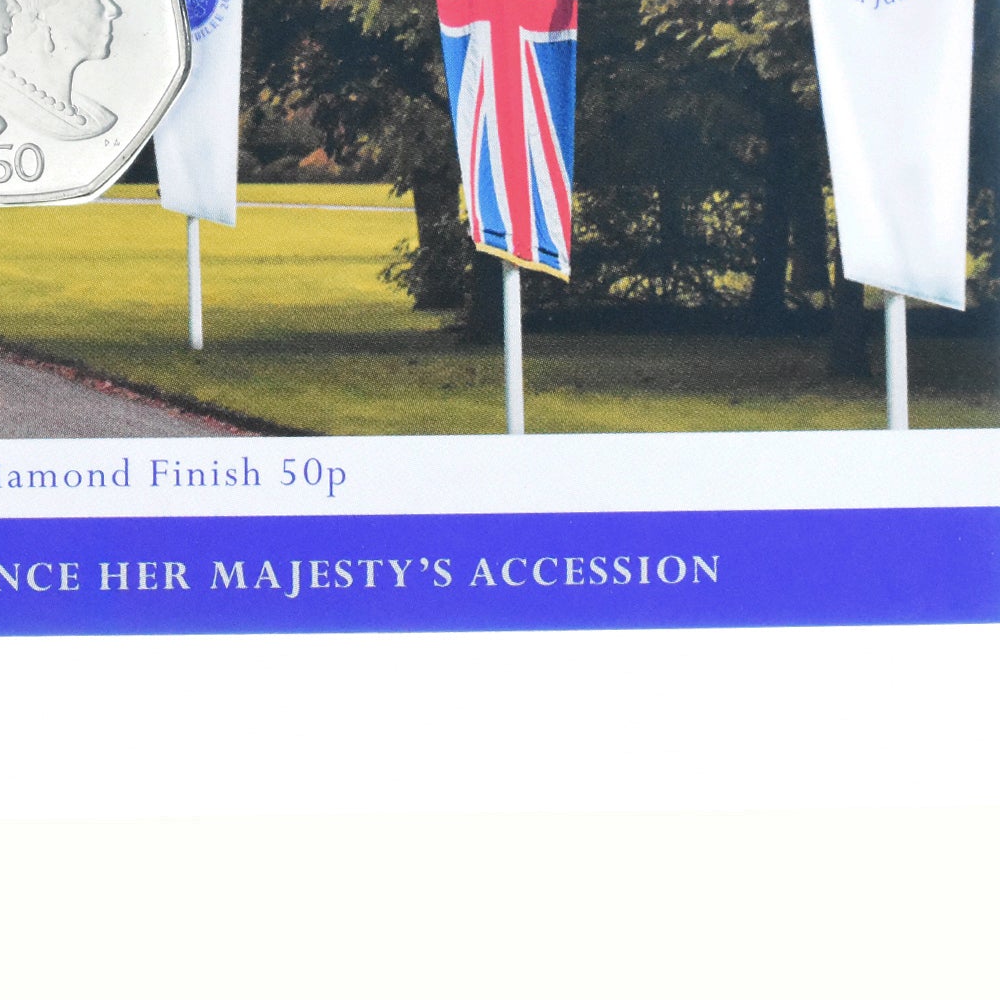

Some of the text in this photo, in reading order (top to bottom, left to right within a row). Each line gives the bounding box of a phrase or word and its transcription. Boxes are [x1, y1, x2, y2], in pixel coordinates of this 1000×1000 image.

[150, 456, 262, 487] Finish
[281, 458, 348, 498] 50p
[99, 561, 191, 591] HER
[209, 557, 453, 599] MAJESTY'S
[469, 555, 721, 588] ACCESSION
